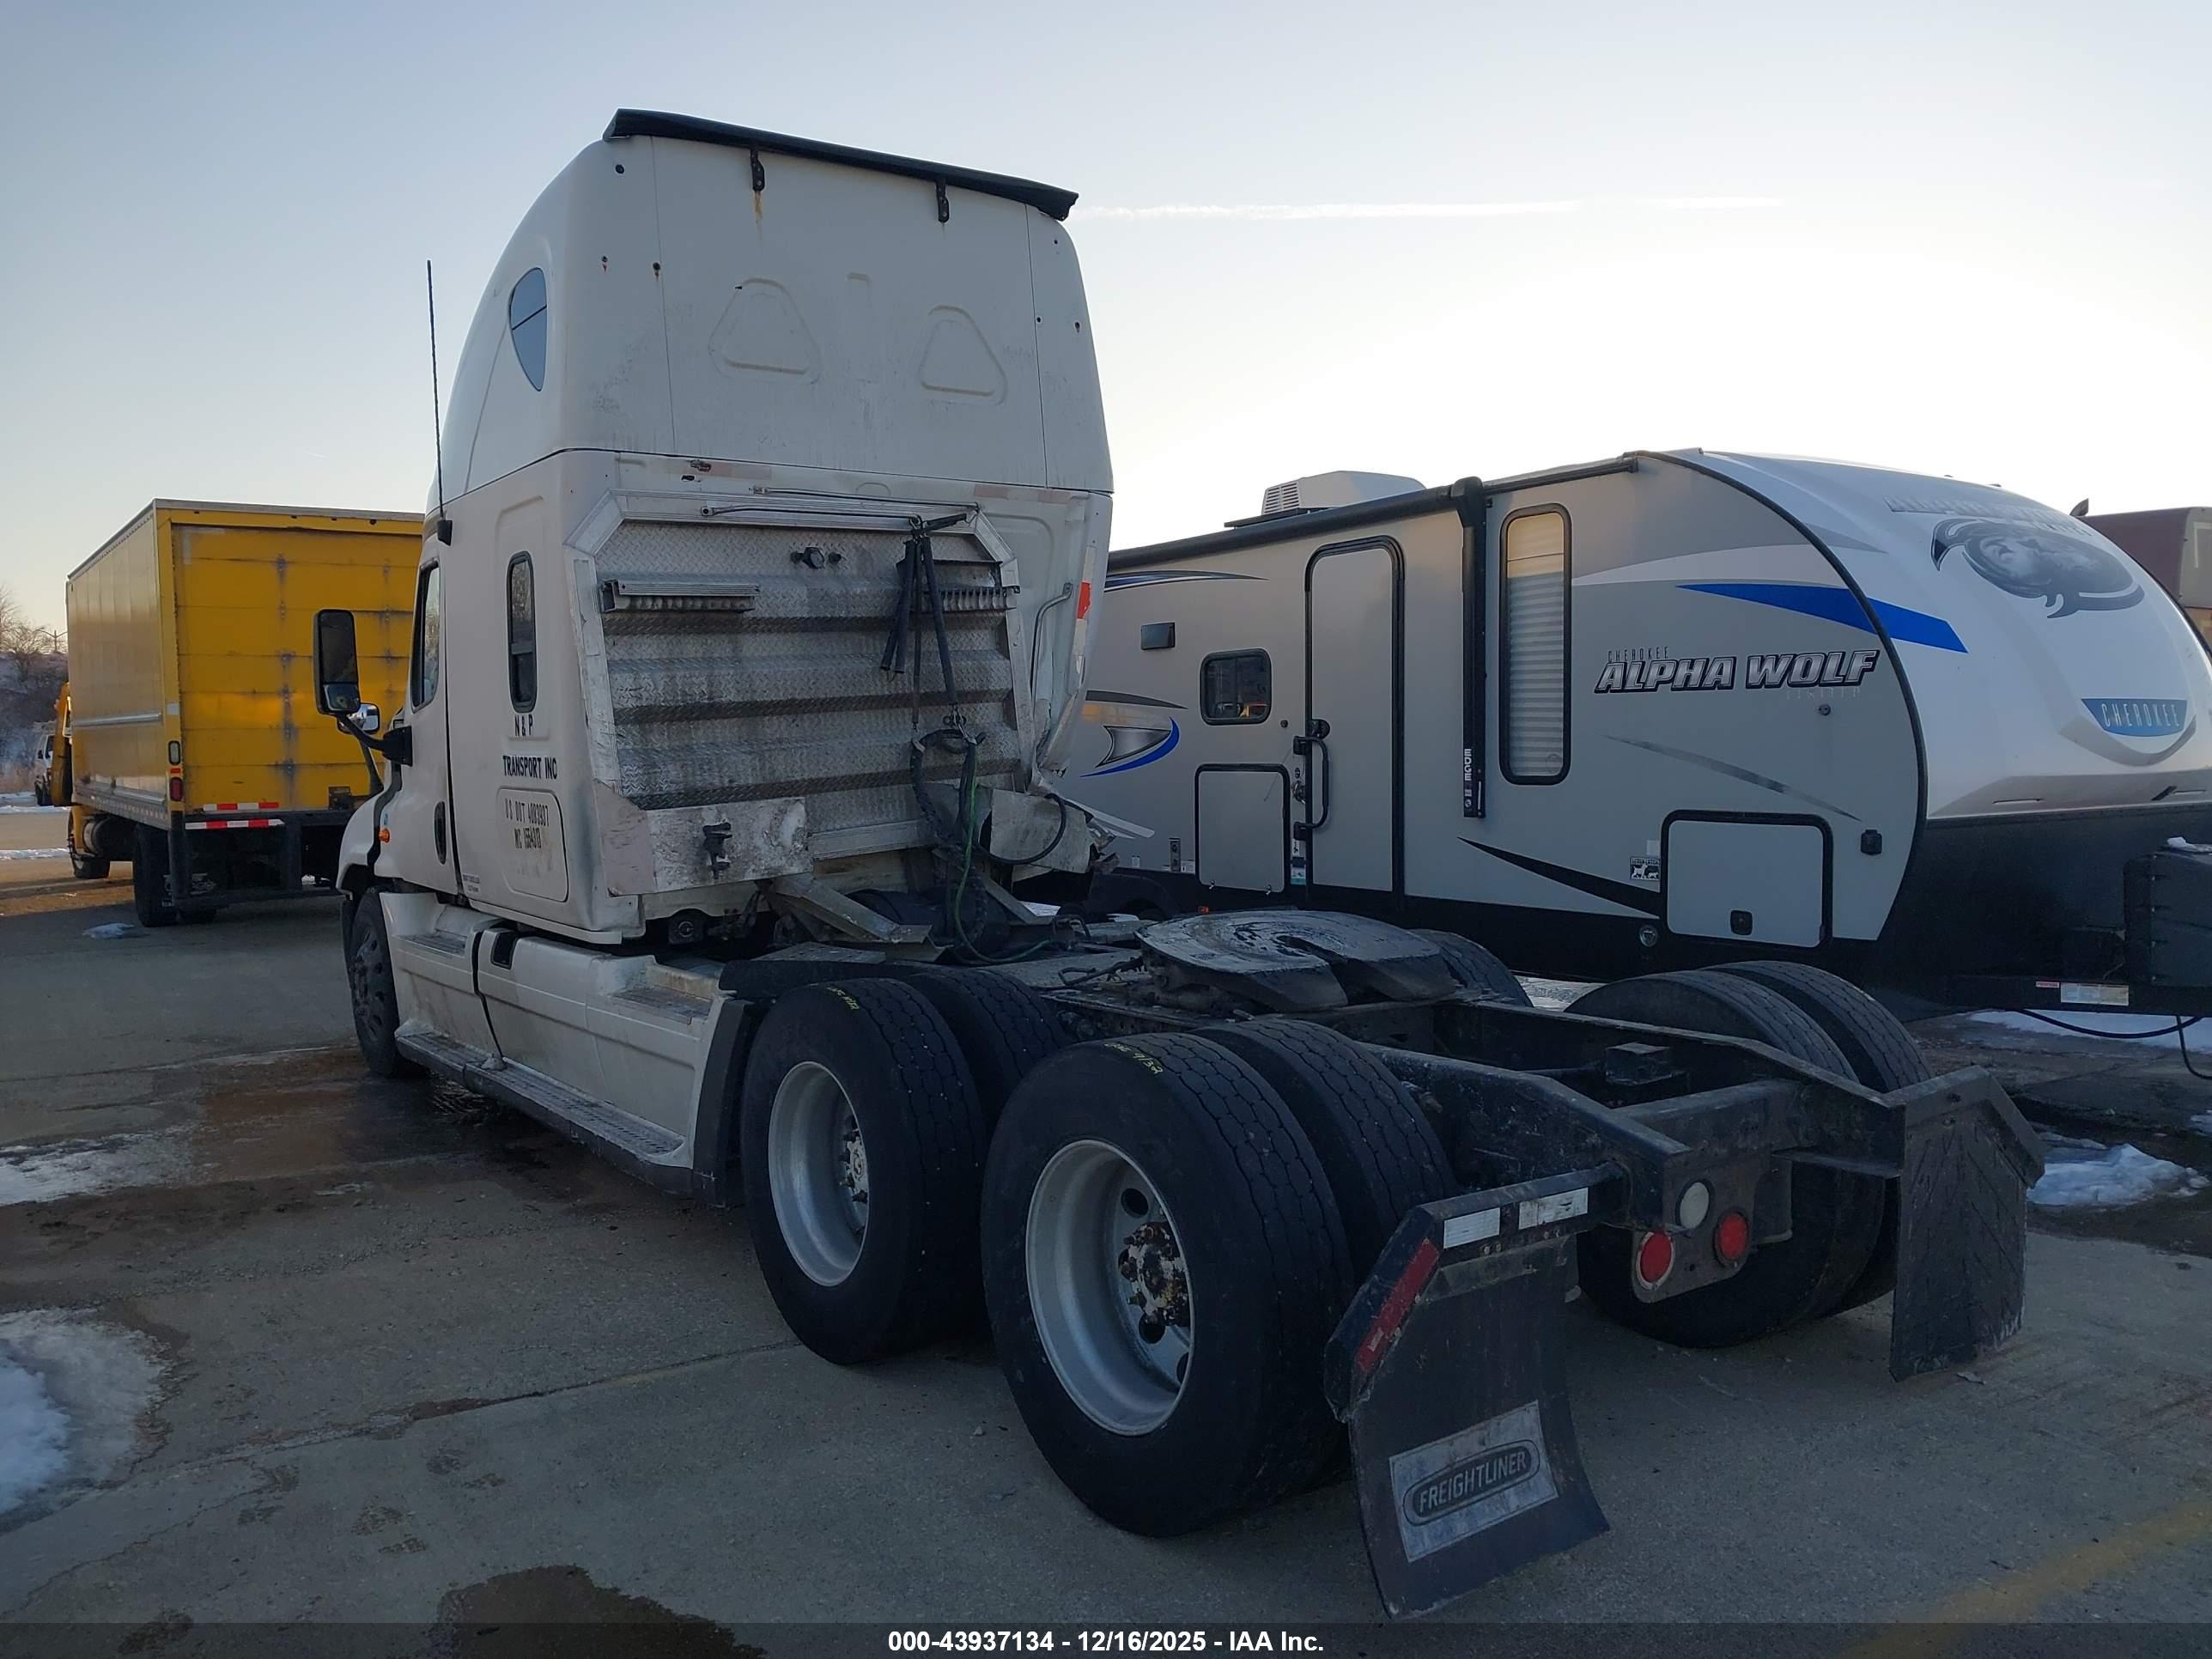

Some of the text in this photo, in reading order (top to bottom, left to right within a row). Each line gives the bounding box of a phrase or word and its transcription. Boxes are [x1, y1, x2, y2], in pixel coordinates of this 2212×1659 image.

[1607, 646, 1669, 663] CHEROKEE
[1595, 650, 1881, 694] ALPHA WOLF
[515, 714, 533, 737] N & P
[2102, 703, 2180, 727] CHEROKEE
[502, 755, 558, 780] TRANSPORT INC
[1419, 1450, 1527, 1513] FREIGHTLINER
